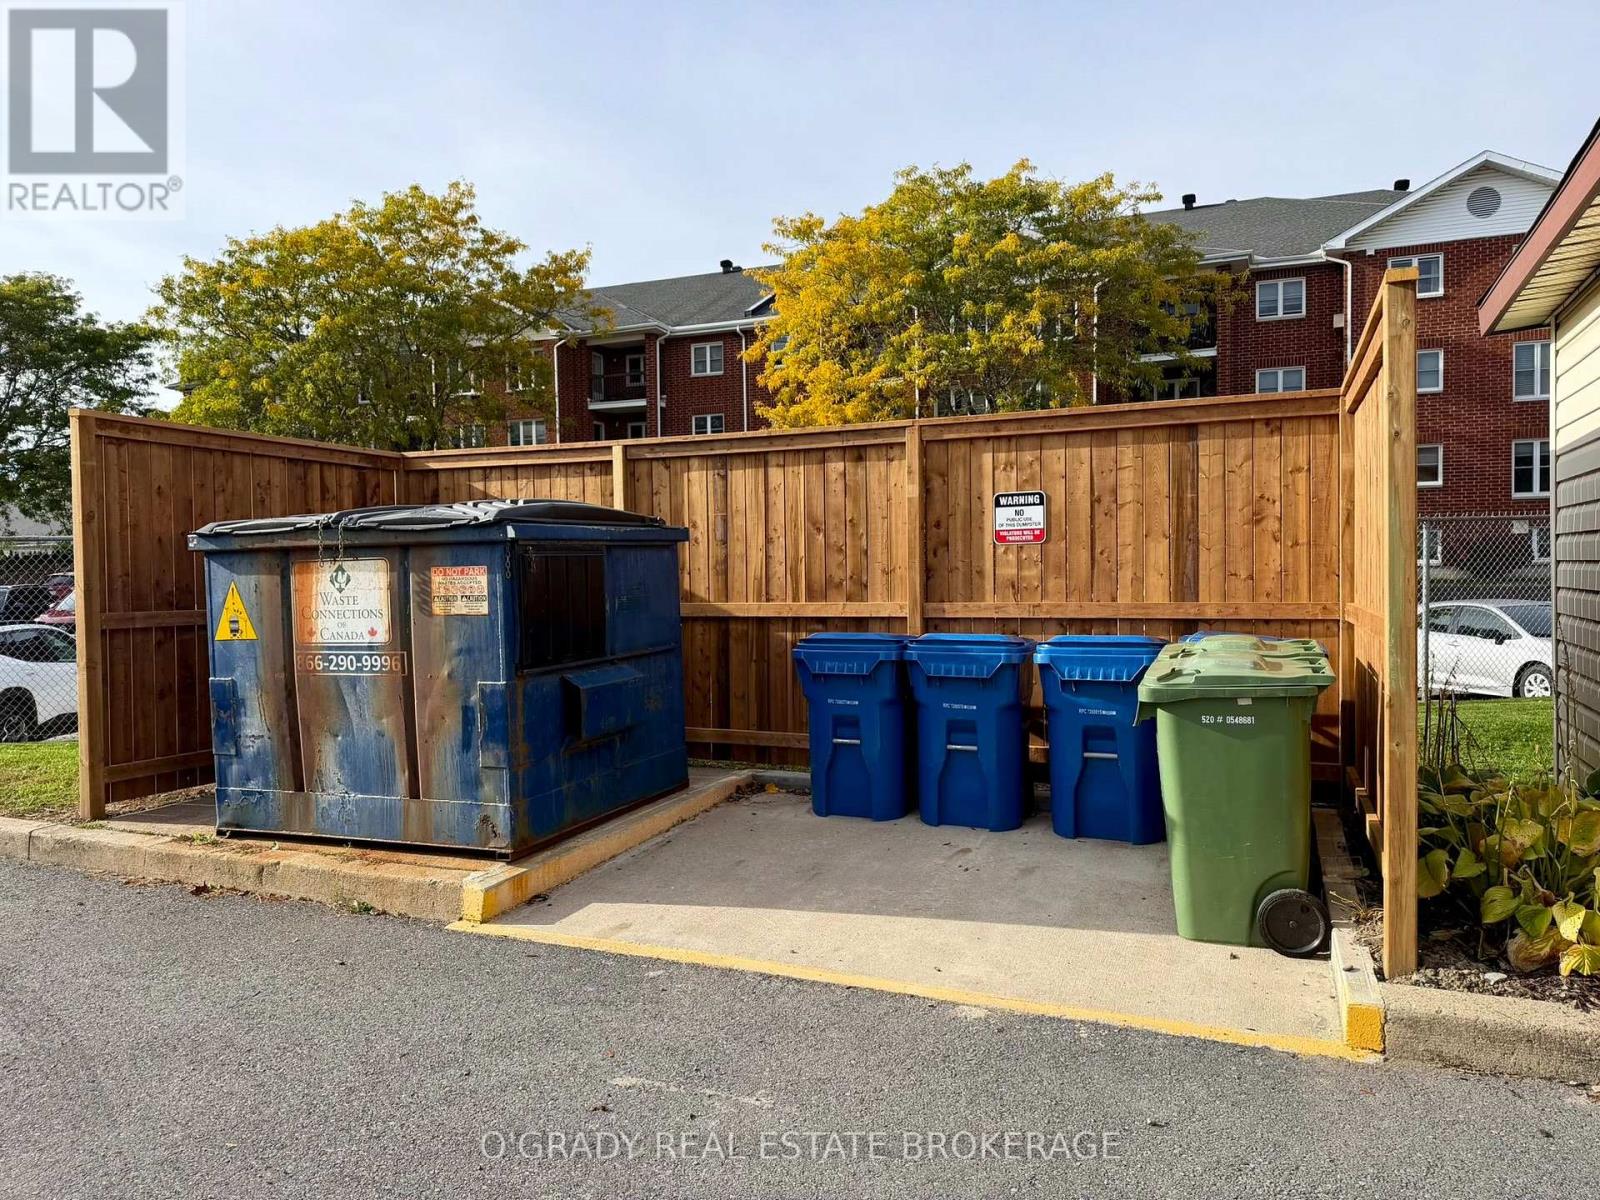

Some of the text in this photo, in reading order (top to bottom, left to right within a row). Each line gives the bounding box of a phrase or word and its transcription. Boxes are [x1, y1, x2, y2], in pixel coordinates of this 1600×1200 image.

[999, 494, 1040, 506] WARNING
[1014, 508, 1025, 517] NO
[432, 567, 486, 576] DO NOT PARK
[319, 592, 360, 606] WASTE
[301, 606, 384, 620] CONNECTIONS
[337, 621, 347, 629] OF
[320, 628, 365, 641] CANADA
[297, 655, 401, 671] 866-290-9996
[1201, 715, 1215, 724] 520
